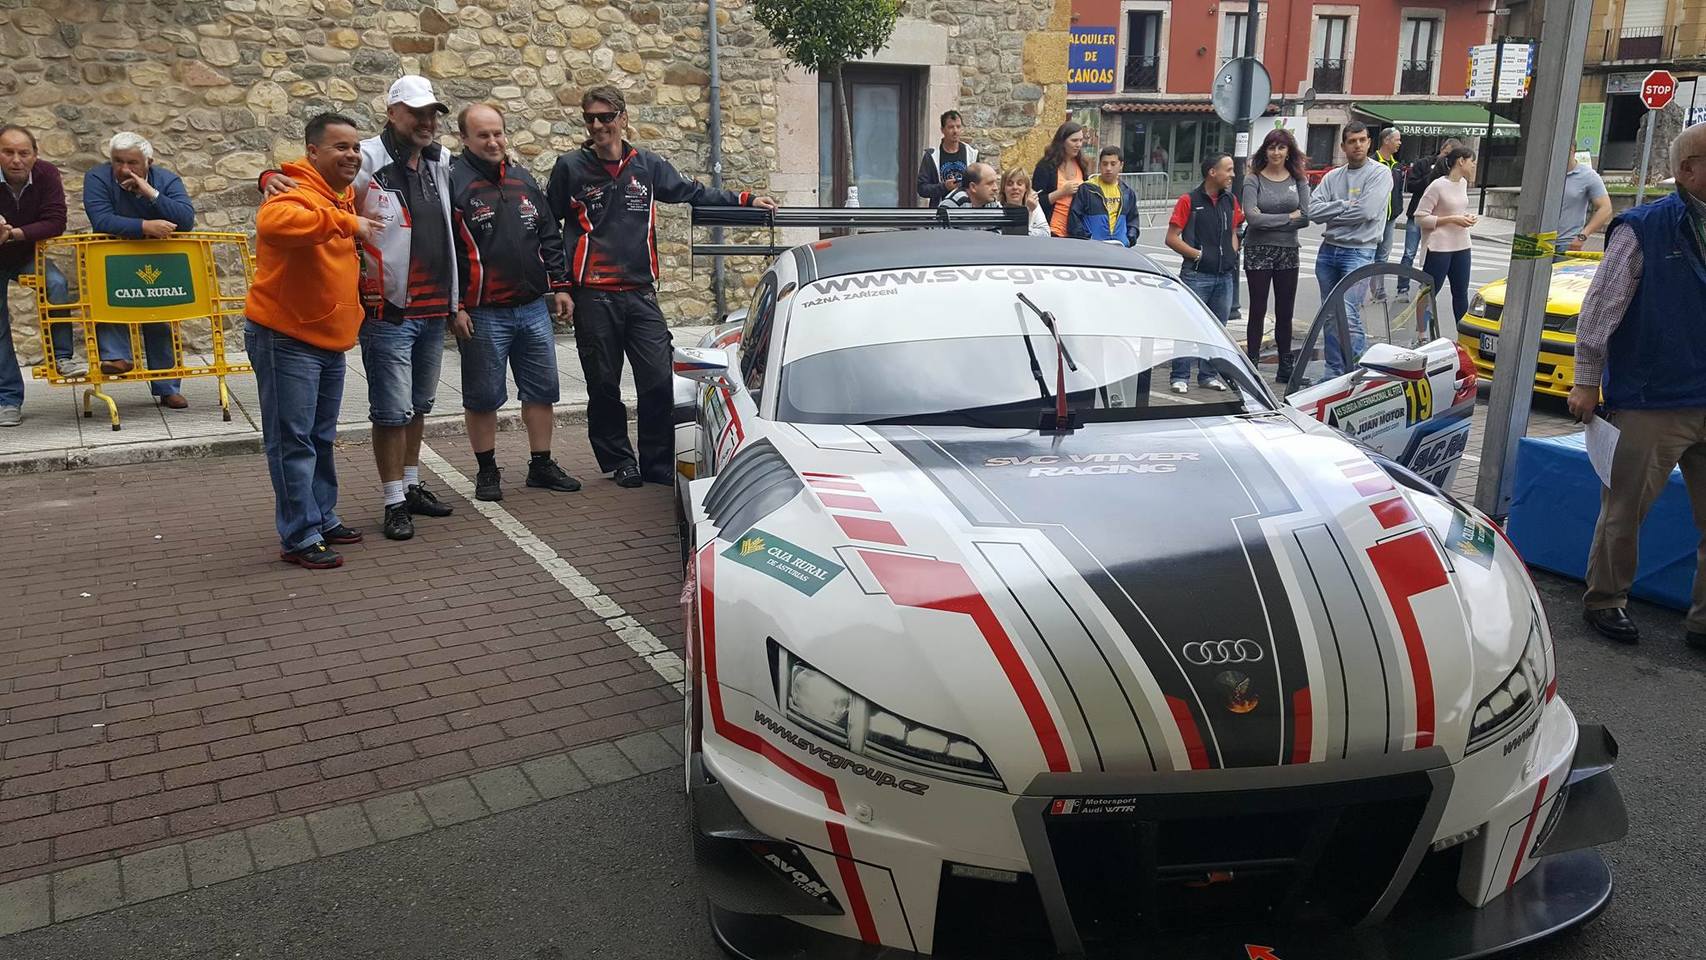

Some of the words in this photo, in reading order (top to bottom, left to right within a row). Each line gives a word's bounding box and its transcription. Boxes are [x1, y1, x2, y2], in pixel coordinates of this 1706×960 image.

[1069, 33, 1116, 45] ALQUILER
[1084, 51, 1098, 61] DE
[1067, 68, 1114, 83] CANOAS
[1645, 85, 1671, 95] STOP
[1464, 127, 1503, 136] YEDA
[812, 268, 1178, 295] www.svcgroup.cz
[115, 288, 141, 298] CAJA
[147, 286, 187, 298] RURAL
[802, 295, 841, 309] TAŽNÁ
[844, 288, 898, 301] ZAŘÍZENÍ
[1405, 377, 1432, 424] 19
[1357, 418, 1379, 435] JUAN
[1379, 408, 1405, 426] MOTOR
[984, 456, 1060, 467] SVC
[1069, 452, 1200, 463] VITVER
[1028, 464, 1177, 478] RACING
[767, 546, 793, 563] CAJA
[791, 557, 829, 580] RURAL
[767, 558, 777, 567] DE
[775, 562, 810, 582] ASTURIAS
[754, 710, 930, 796] www.svcgroup.cz
[1085, 798, 1137, 806] Motorsport
[764, 854, 830, 895] AVON
